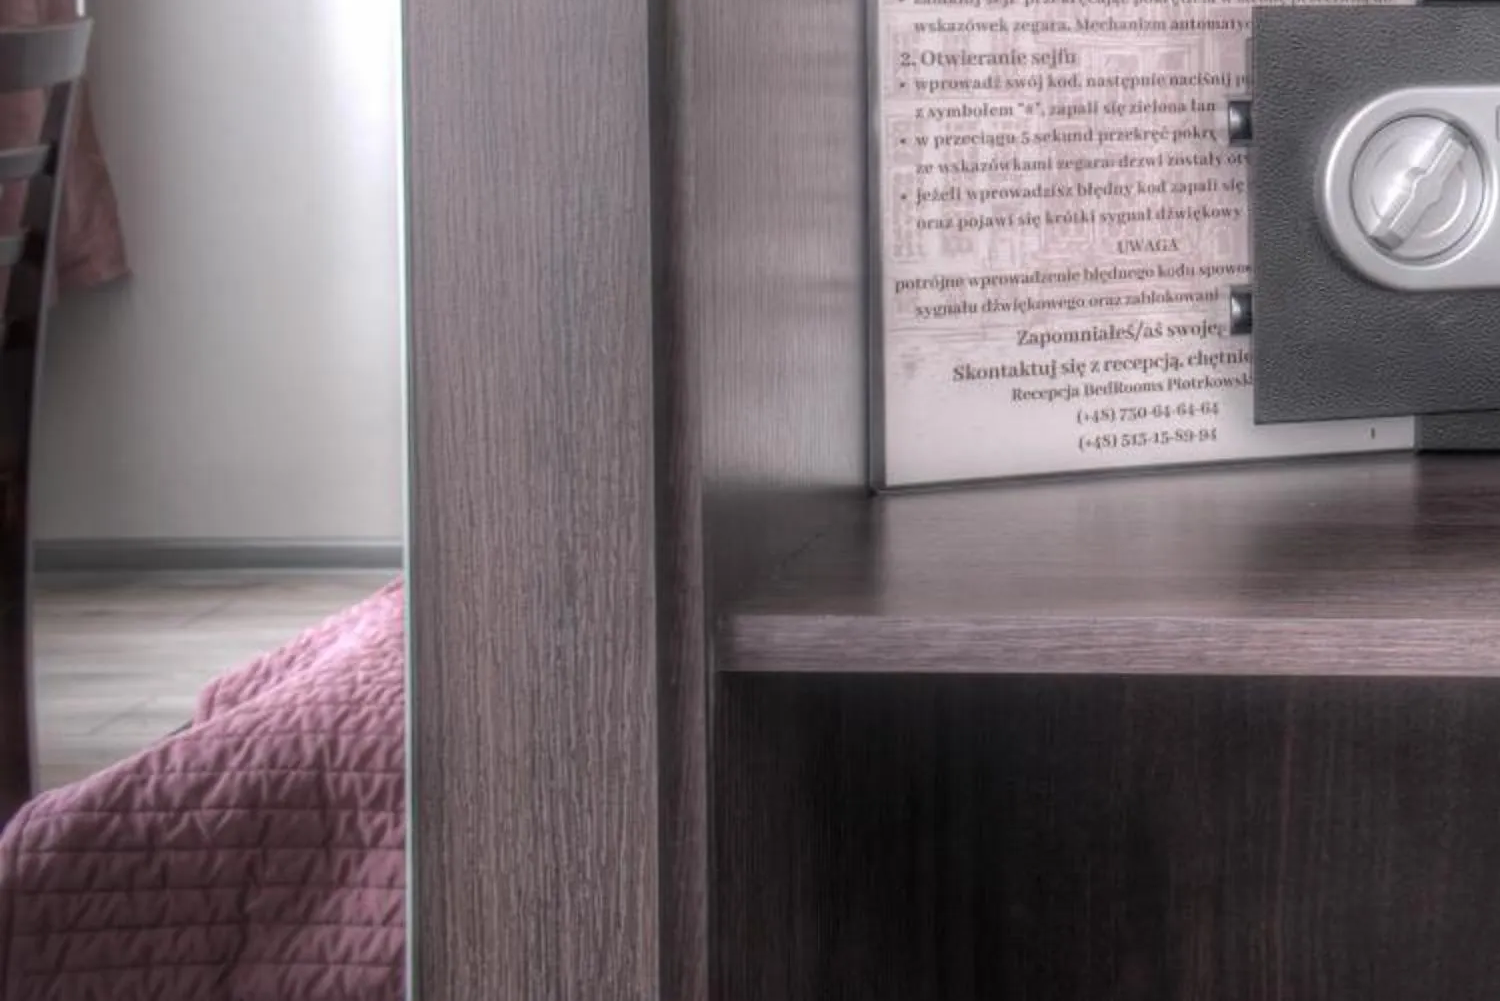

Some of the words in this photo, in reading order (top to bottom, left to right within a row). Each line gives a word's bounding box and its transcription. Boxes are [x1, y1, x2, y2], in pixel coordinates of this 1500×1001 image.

[914, 17, 1009, 32] wskazówek
[1076, 17, 1166, 32] Mechanizm
[900, 52, 916, 67] 2.
[920, 49, 1026, 67] Otwieranie
[1031, 47, 1077, 69] sejfu
[915, 76, 1001, 93] wprowadź
[1005, 76, 1043, 92] swój
[1086, 74, 1167, 92] następnie
[1169, 72, 1231, 89] naciśnij
[915, 108, 923, 118] z
[927, 103, 1013, 120] symbolem
[1050, 100, 1098, 118] zapali
[1103, 100, 1125, 116] się
[1129, 99, 1186, 114] zielona
[916, 135, 928, 146] w
[934, 132, 1015, 149] przeciągu
[1021, 132, 1030, 145] 5
[1034, 128, 1093, 145] sekund
[916, 163, 933, 174] ze
[938, 156, 1052, 174] wskazówkami
[1167, 150, 1221, 167] zostały
[916, 186, 961, 206] jeżeli
[967, 183, 1073, 202] wprowadzisz
[1077, 181, 1131, 199] błędny
[1136, 180, 1165, 194] kod
[1170, 179, 1217, 196] zapali
[1222, 178, 1244, 195] się
[916, 217, 953, 230] oraz
[957, 214, 1014, 232] pojawi
[1018, 213, 1042, 229] się
[1045, 209, 1095, 225] krótki
[1100, 207, 1150, 225] sygnał
[1155, 205, 1241, 223] dźwiękowy
[1117, 238, 1179, 254] UWAGA
[895, 275, 964, 294] potrójne
[968, 269, 1081, 290] wprowadzenie
[1083, 265, 1153, 283] błędnego
[1158, 261, 1195, 276] kodu
[915, 300, 977, 319] sygnału
[982, 295, 1085, 314] dźwiękowego
[1089, 294, 1121, 308] oraz
[1017, 319, 1162, 348] Zapomniałeś/aś
[953, 359, 1057, 382] Skontaktuj
[1061, 357, 1087, 376] się
[1090, 359, 1100, 373] z
[1012, 384, 1080, 403] Recepcja
[1084, 380, 1163, 397] BedRooms
[1077, 408, 1115, 424] (+48)
[1079, 434, 1117, 452] (+48)
